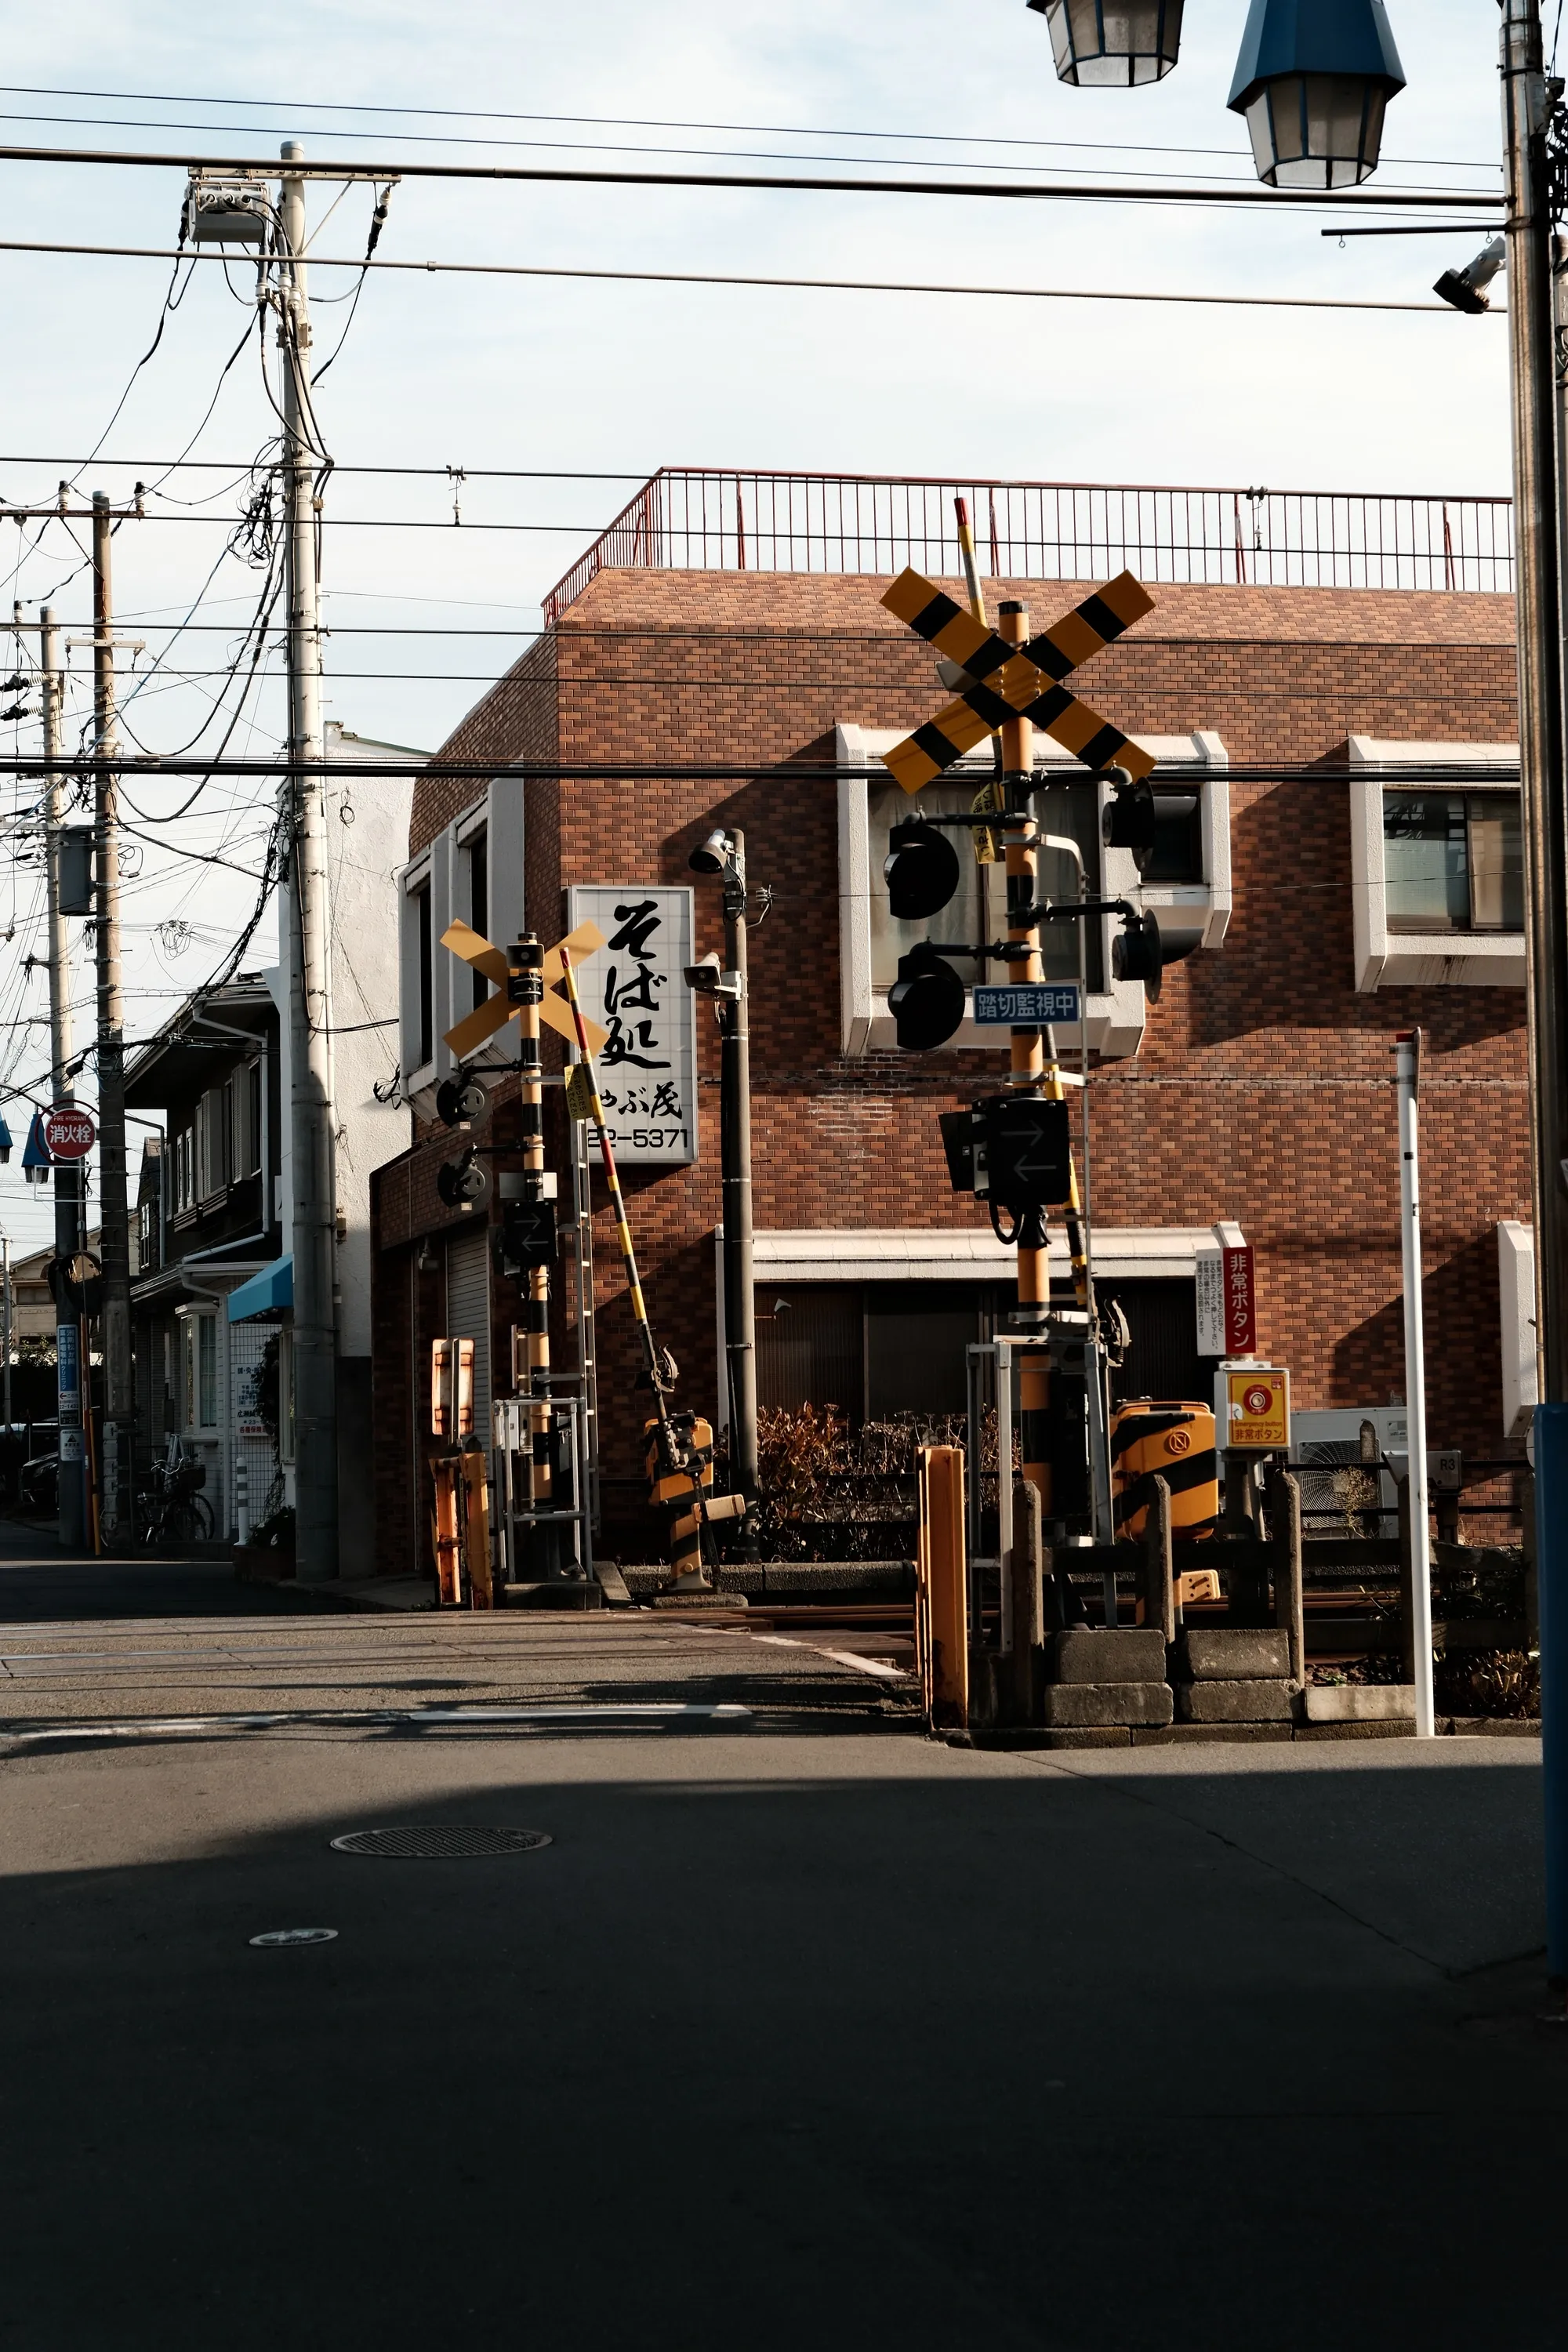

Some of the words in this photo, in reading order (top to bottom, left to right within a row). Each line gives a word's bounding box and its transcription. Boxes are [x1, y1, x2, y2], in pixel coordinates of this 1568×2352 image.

[974, 797, 989, 856] お待下さい
[599, 899, 672, 1069] そば処
[978, 992, 1074, 1018] 踏切監視中
[49, 1124, 92, 1143] 消火栓
[588, 1129, 688, 1149] 22-5371
[1229, 1254, 1249, 1348] 非常ボタン
[1235, 1428, 1283, 1440] 非常ボタン
[1439, 1458, 1456, 1471] R3
